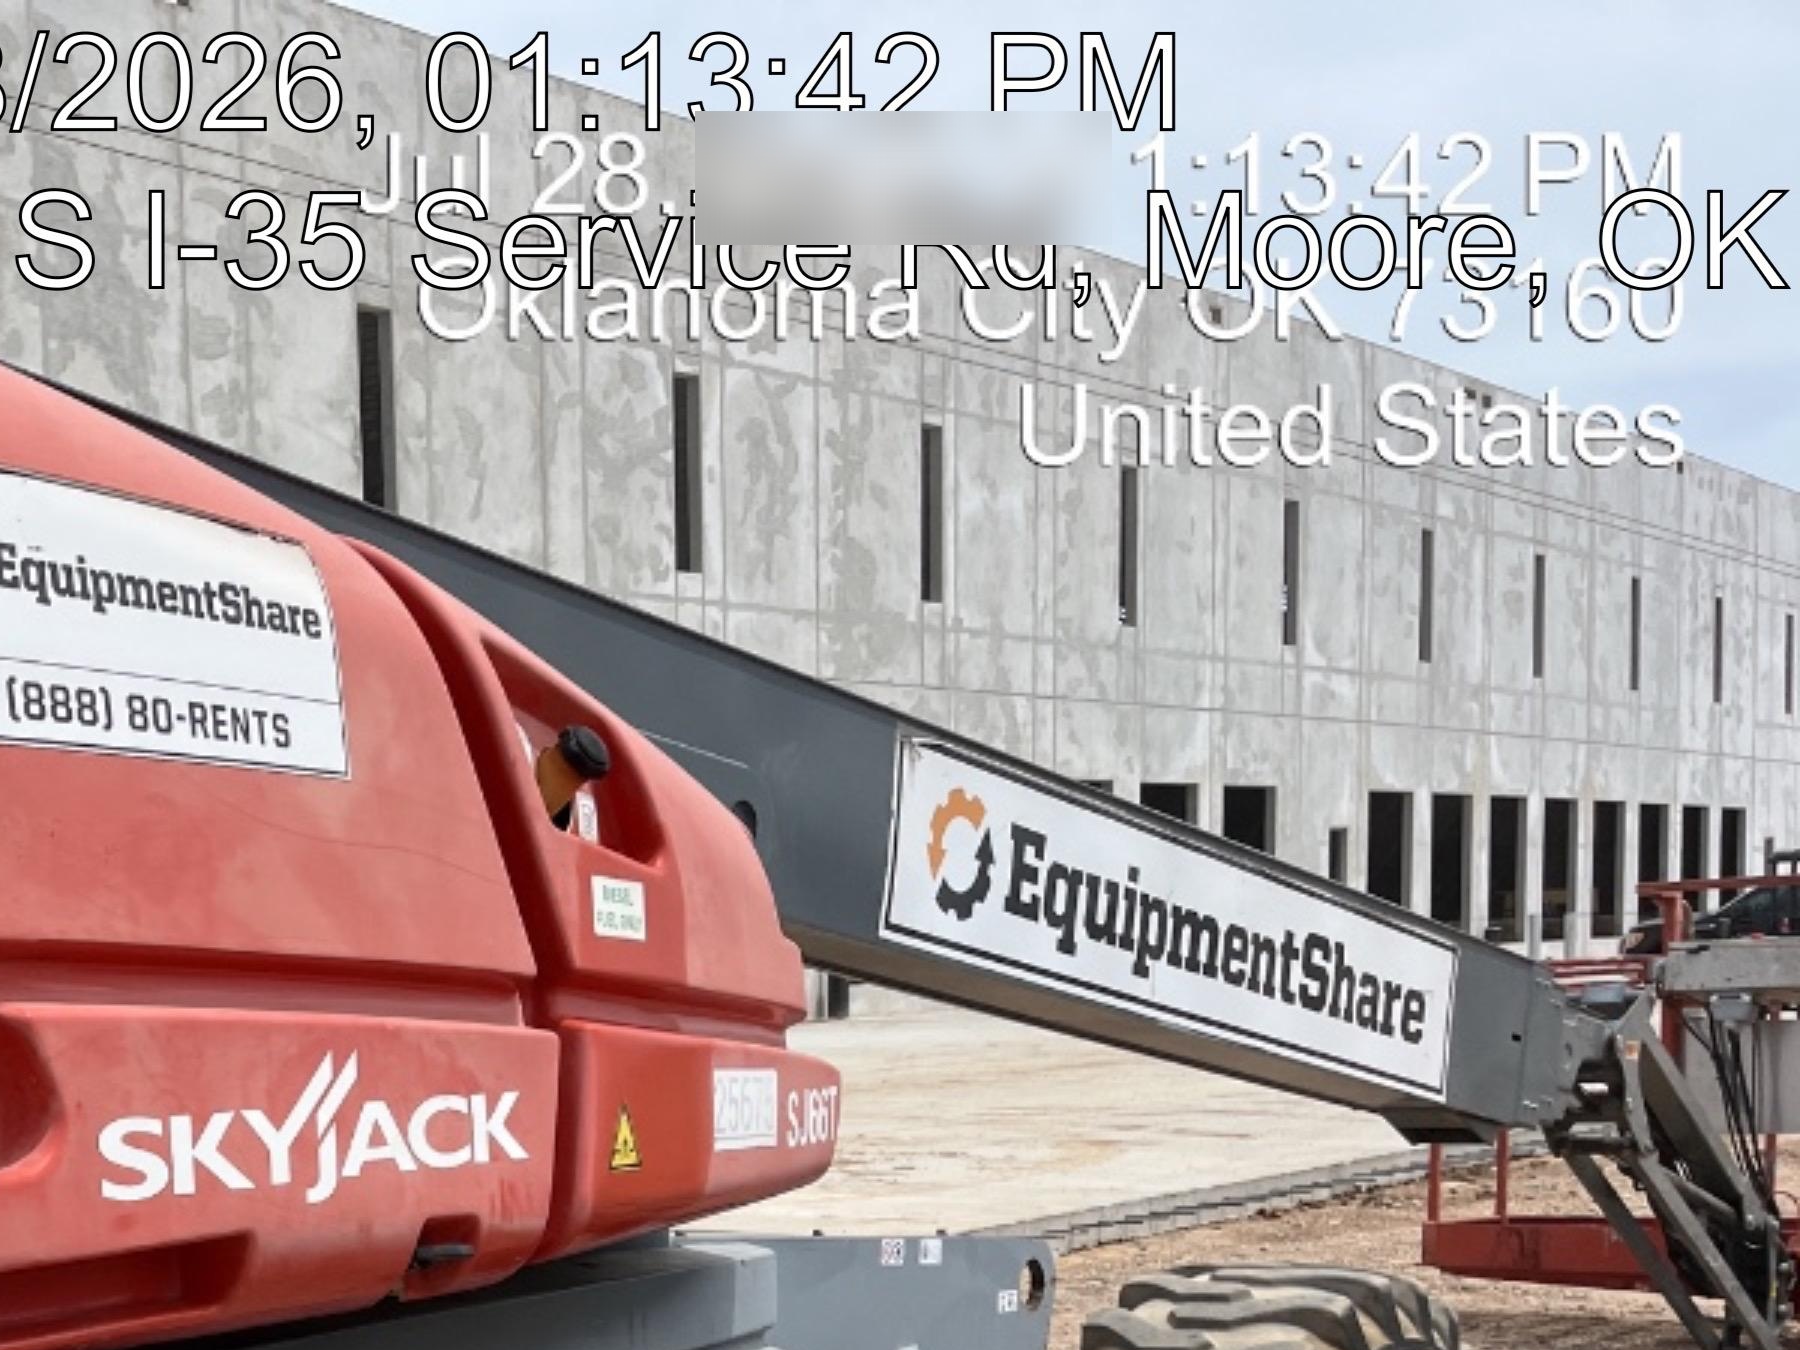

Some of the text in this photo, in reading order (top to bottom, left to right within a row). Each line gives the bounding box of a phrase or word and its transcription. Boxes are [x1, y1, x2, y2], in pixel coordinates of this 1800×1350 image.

[6, 675, 291, 749] (888) 80-RENTS
[1004, 822, 1426, 1045] EquipmentShare
[97, 1048, 529, 1204] SKYJACK
